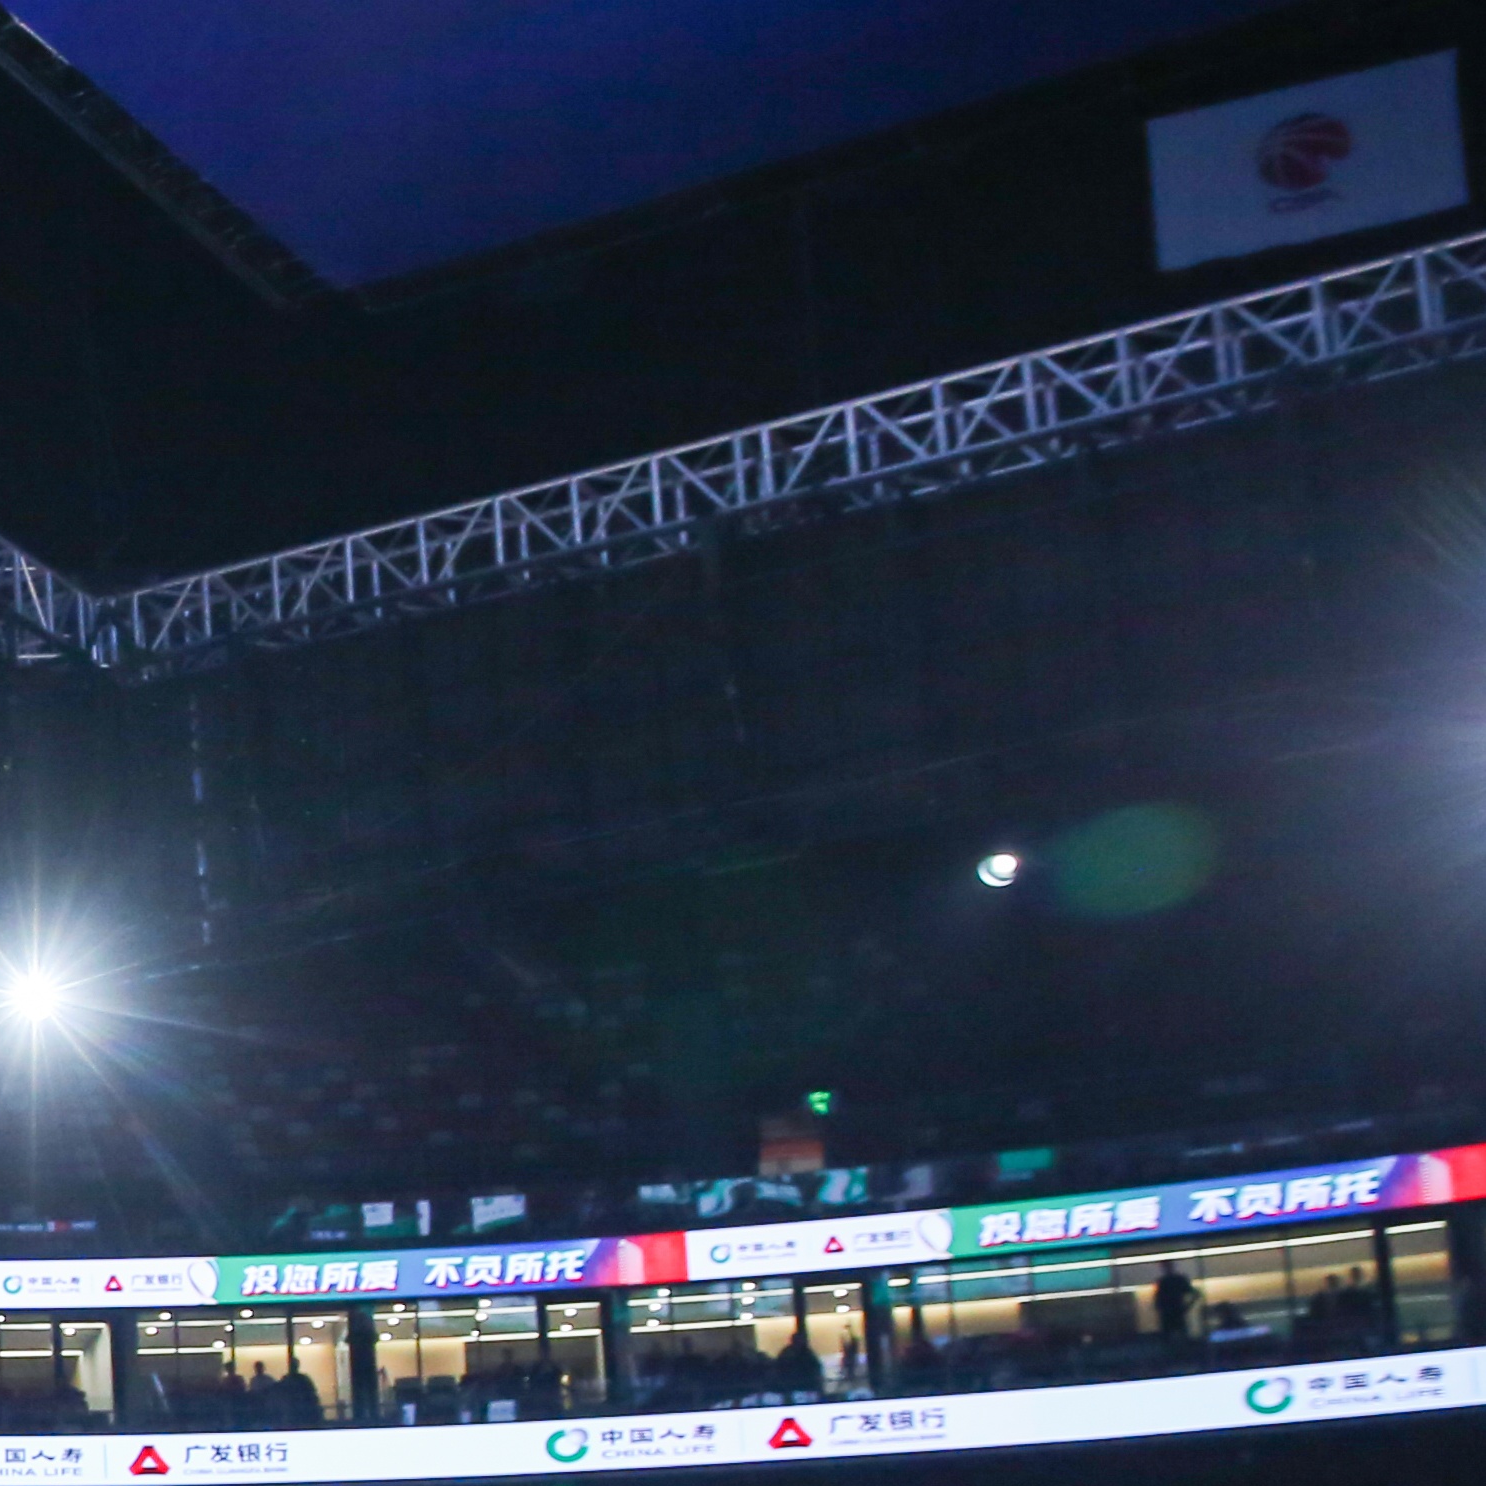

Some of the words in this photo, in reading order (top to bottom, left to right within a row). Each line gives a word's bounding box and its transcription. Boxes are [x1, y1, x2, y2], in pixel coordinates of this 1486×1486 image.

[978, 1196, 1160, 1249] 投您所爱
[1189, 1169, 1381, 1224] 不负所托
[242, 1261, 398, 1296] 投您所爱
[425, 1250, 586, 1290] 不负所托
[1307, 1366, 1445, 1392] 中国人寿
[830, 1408, 946, 1434] 广发银行
[600, 1425, 716, 1445] 中国人寿
[184, 1442, 288, 1464] 广发银行
[601, 1446, 666, 1461] CHINA
[672, 1443, 716, 1457] LIFE
[43, 1466, 84, 1478] LIFE
